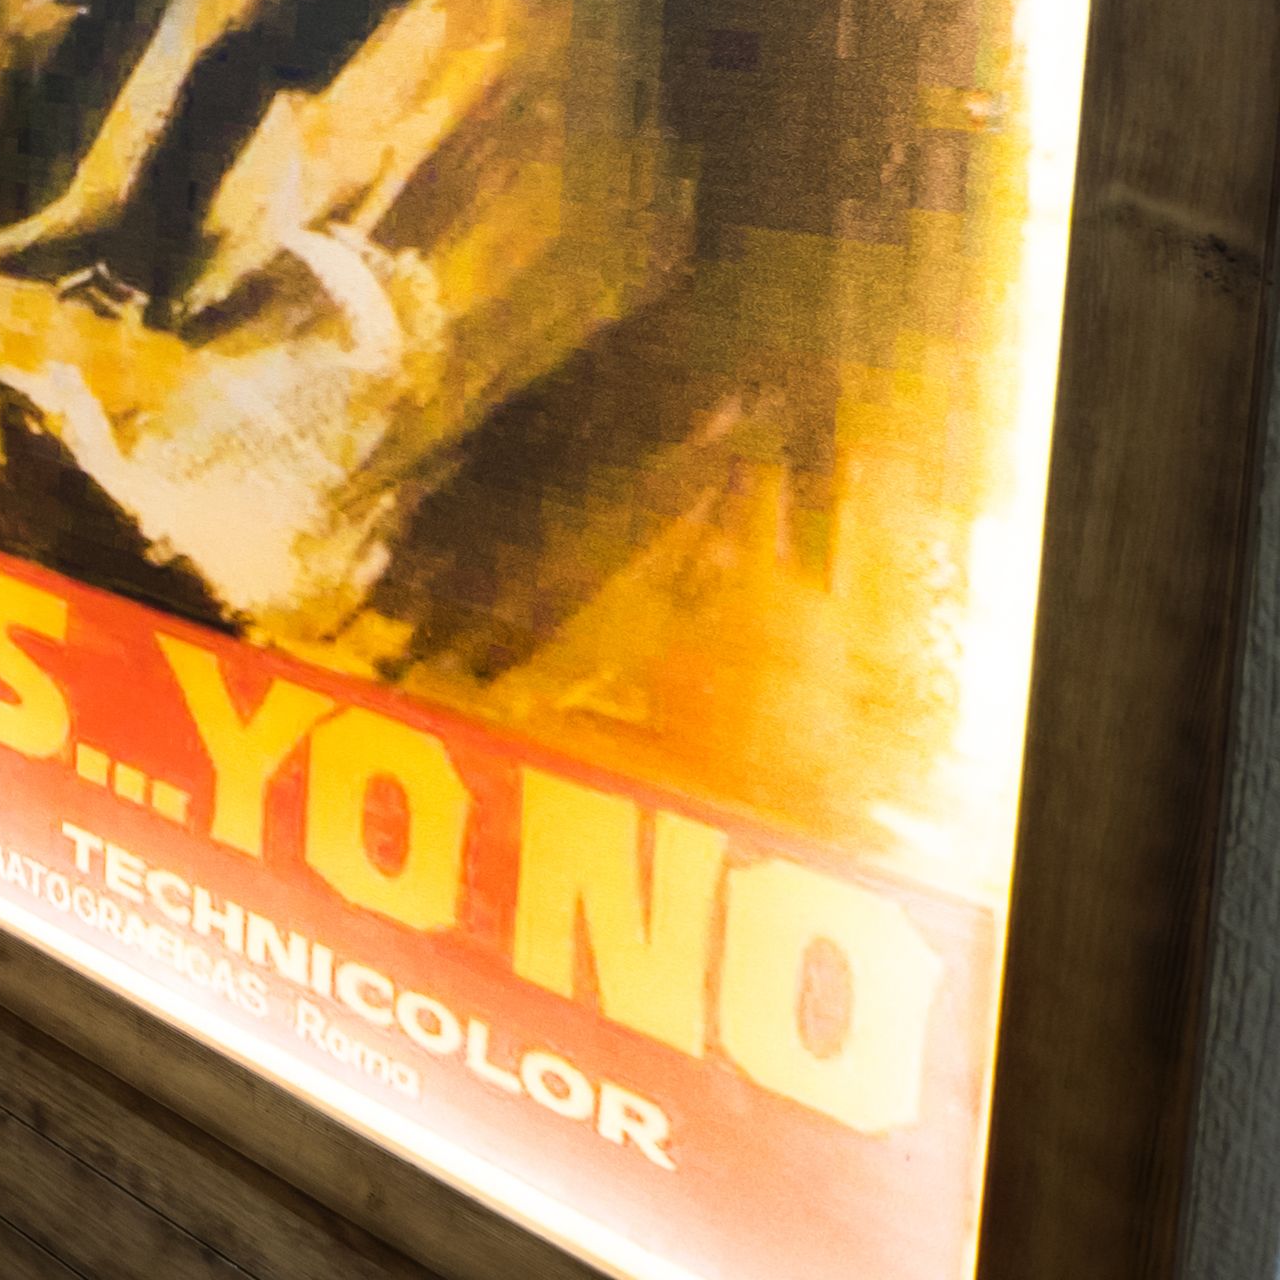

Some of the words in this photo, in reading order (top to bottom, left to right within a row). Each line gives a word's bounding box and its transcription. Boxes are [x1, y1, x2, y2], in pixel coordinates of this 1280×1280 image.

[61, 820, 678, 1172] TECHNICOLOR
[158, 631, 469, 933] YO
[514, 765, 943, 1133] NO
[295, 998, 421, 1098] Roma
